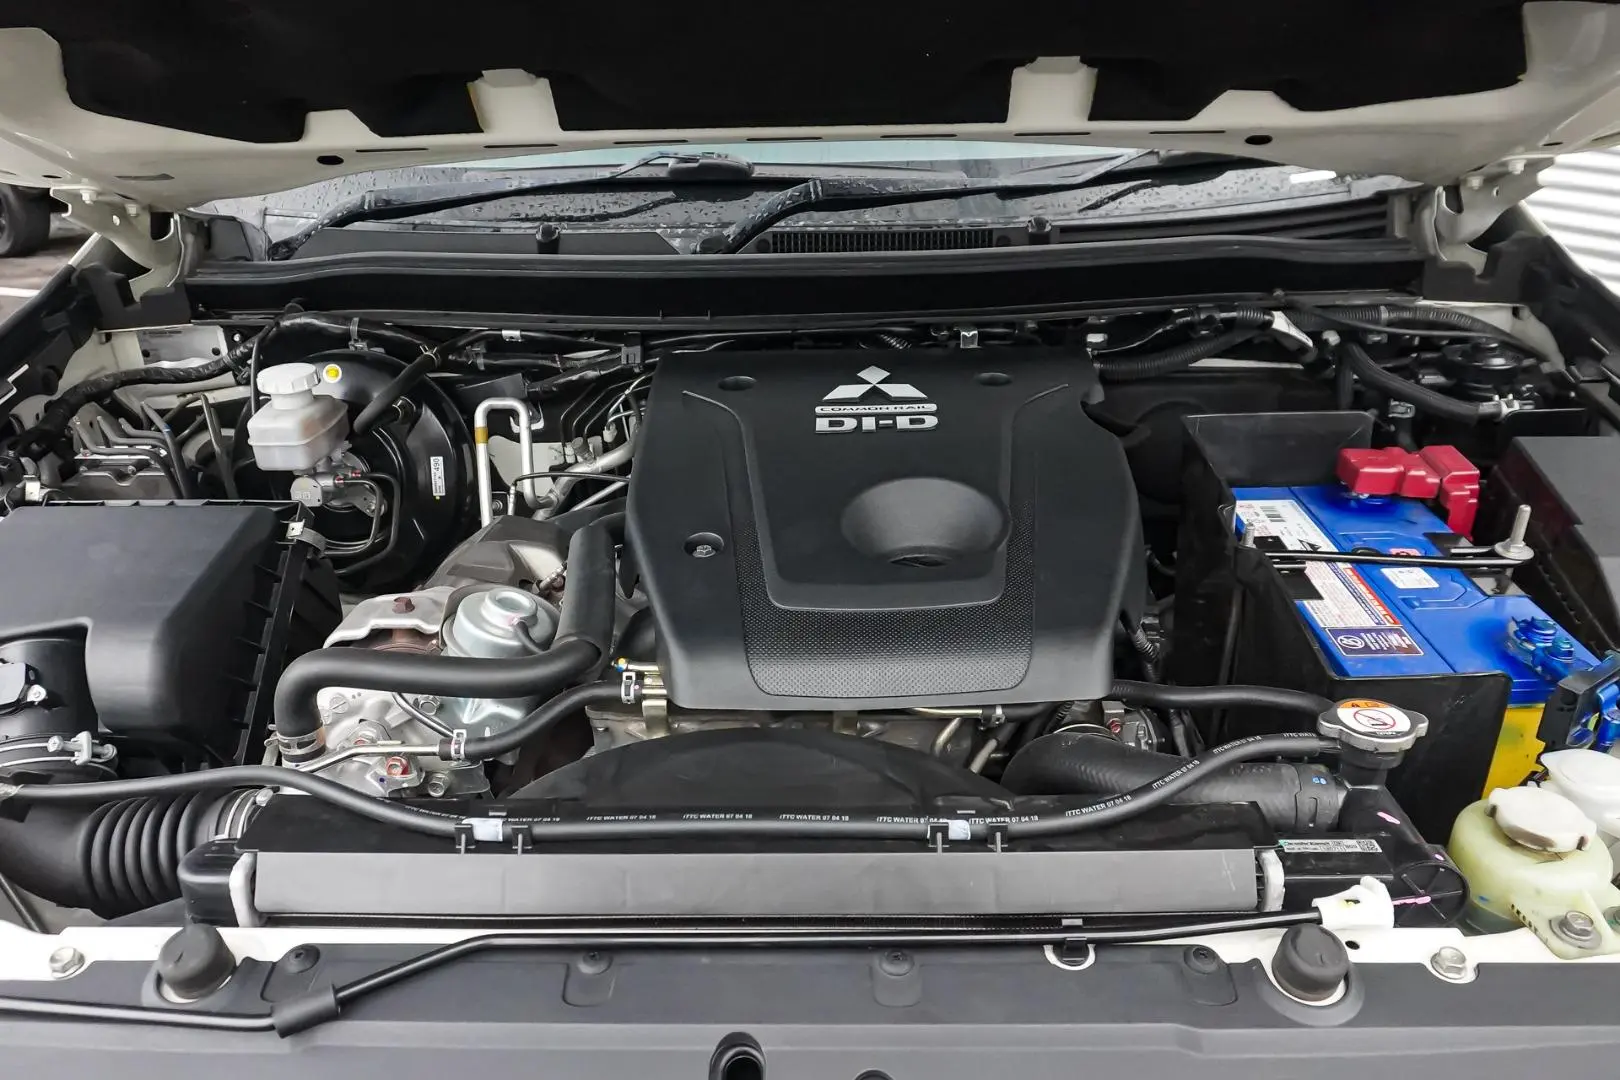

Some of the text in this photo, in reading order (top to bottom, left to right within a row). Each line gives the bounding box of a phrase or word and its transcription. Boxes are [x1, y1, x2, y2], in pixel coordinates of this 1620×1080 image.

[1163, 769, 1183, 783] WATER
[1080, 803, 1107, 814] WATER
[985, 816, 1011, 824] WATER
